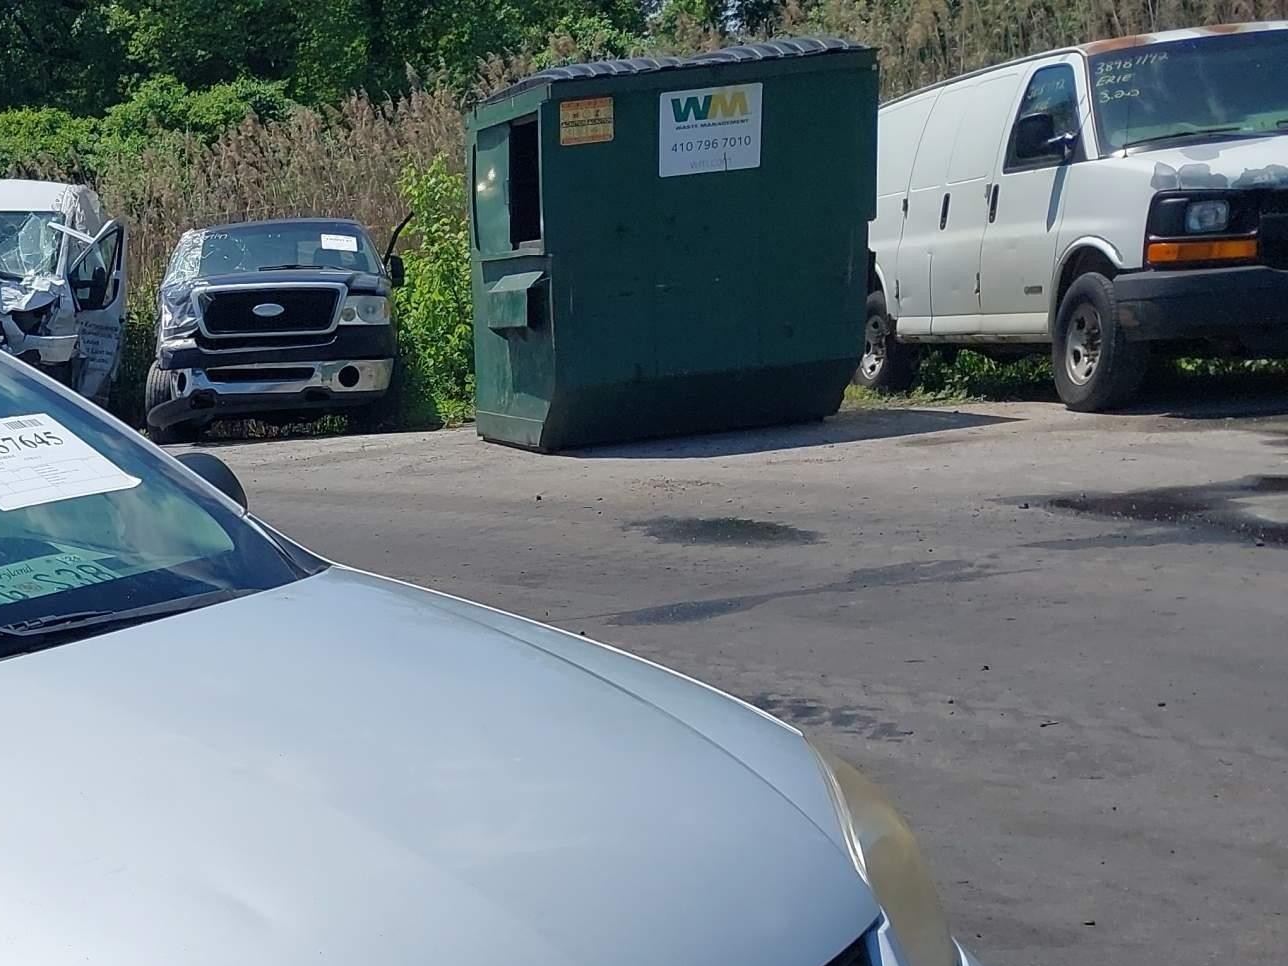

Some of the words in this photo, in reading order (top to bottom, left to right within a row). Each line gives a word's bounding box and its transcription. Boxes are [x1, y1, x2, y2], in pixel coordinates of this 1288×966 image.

[1096, 73, 1136, 87] ERIE
[671, 91, 749, 122] WM
[676, 123, 698, 131] WASTE
[700, 118, 749, 128] MANAGEMENT
[672, 141, 693, 153] 410
[696, 138, 719, 150] 796
[722, 135, 752, 148] 7010
